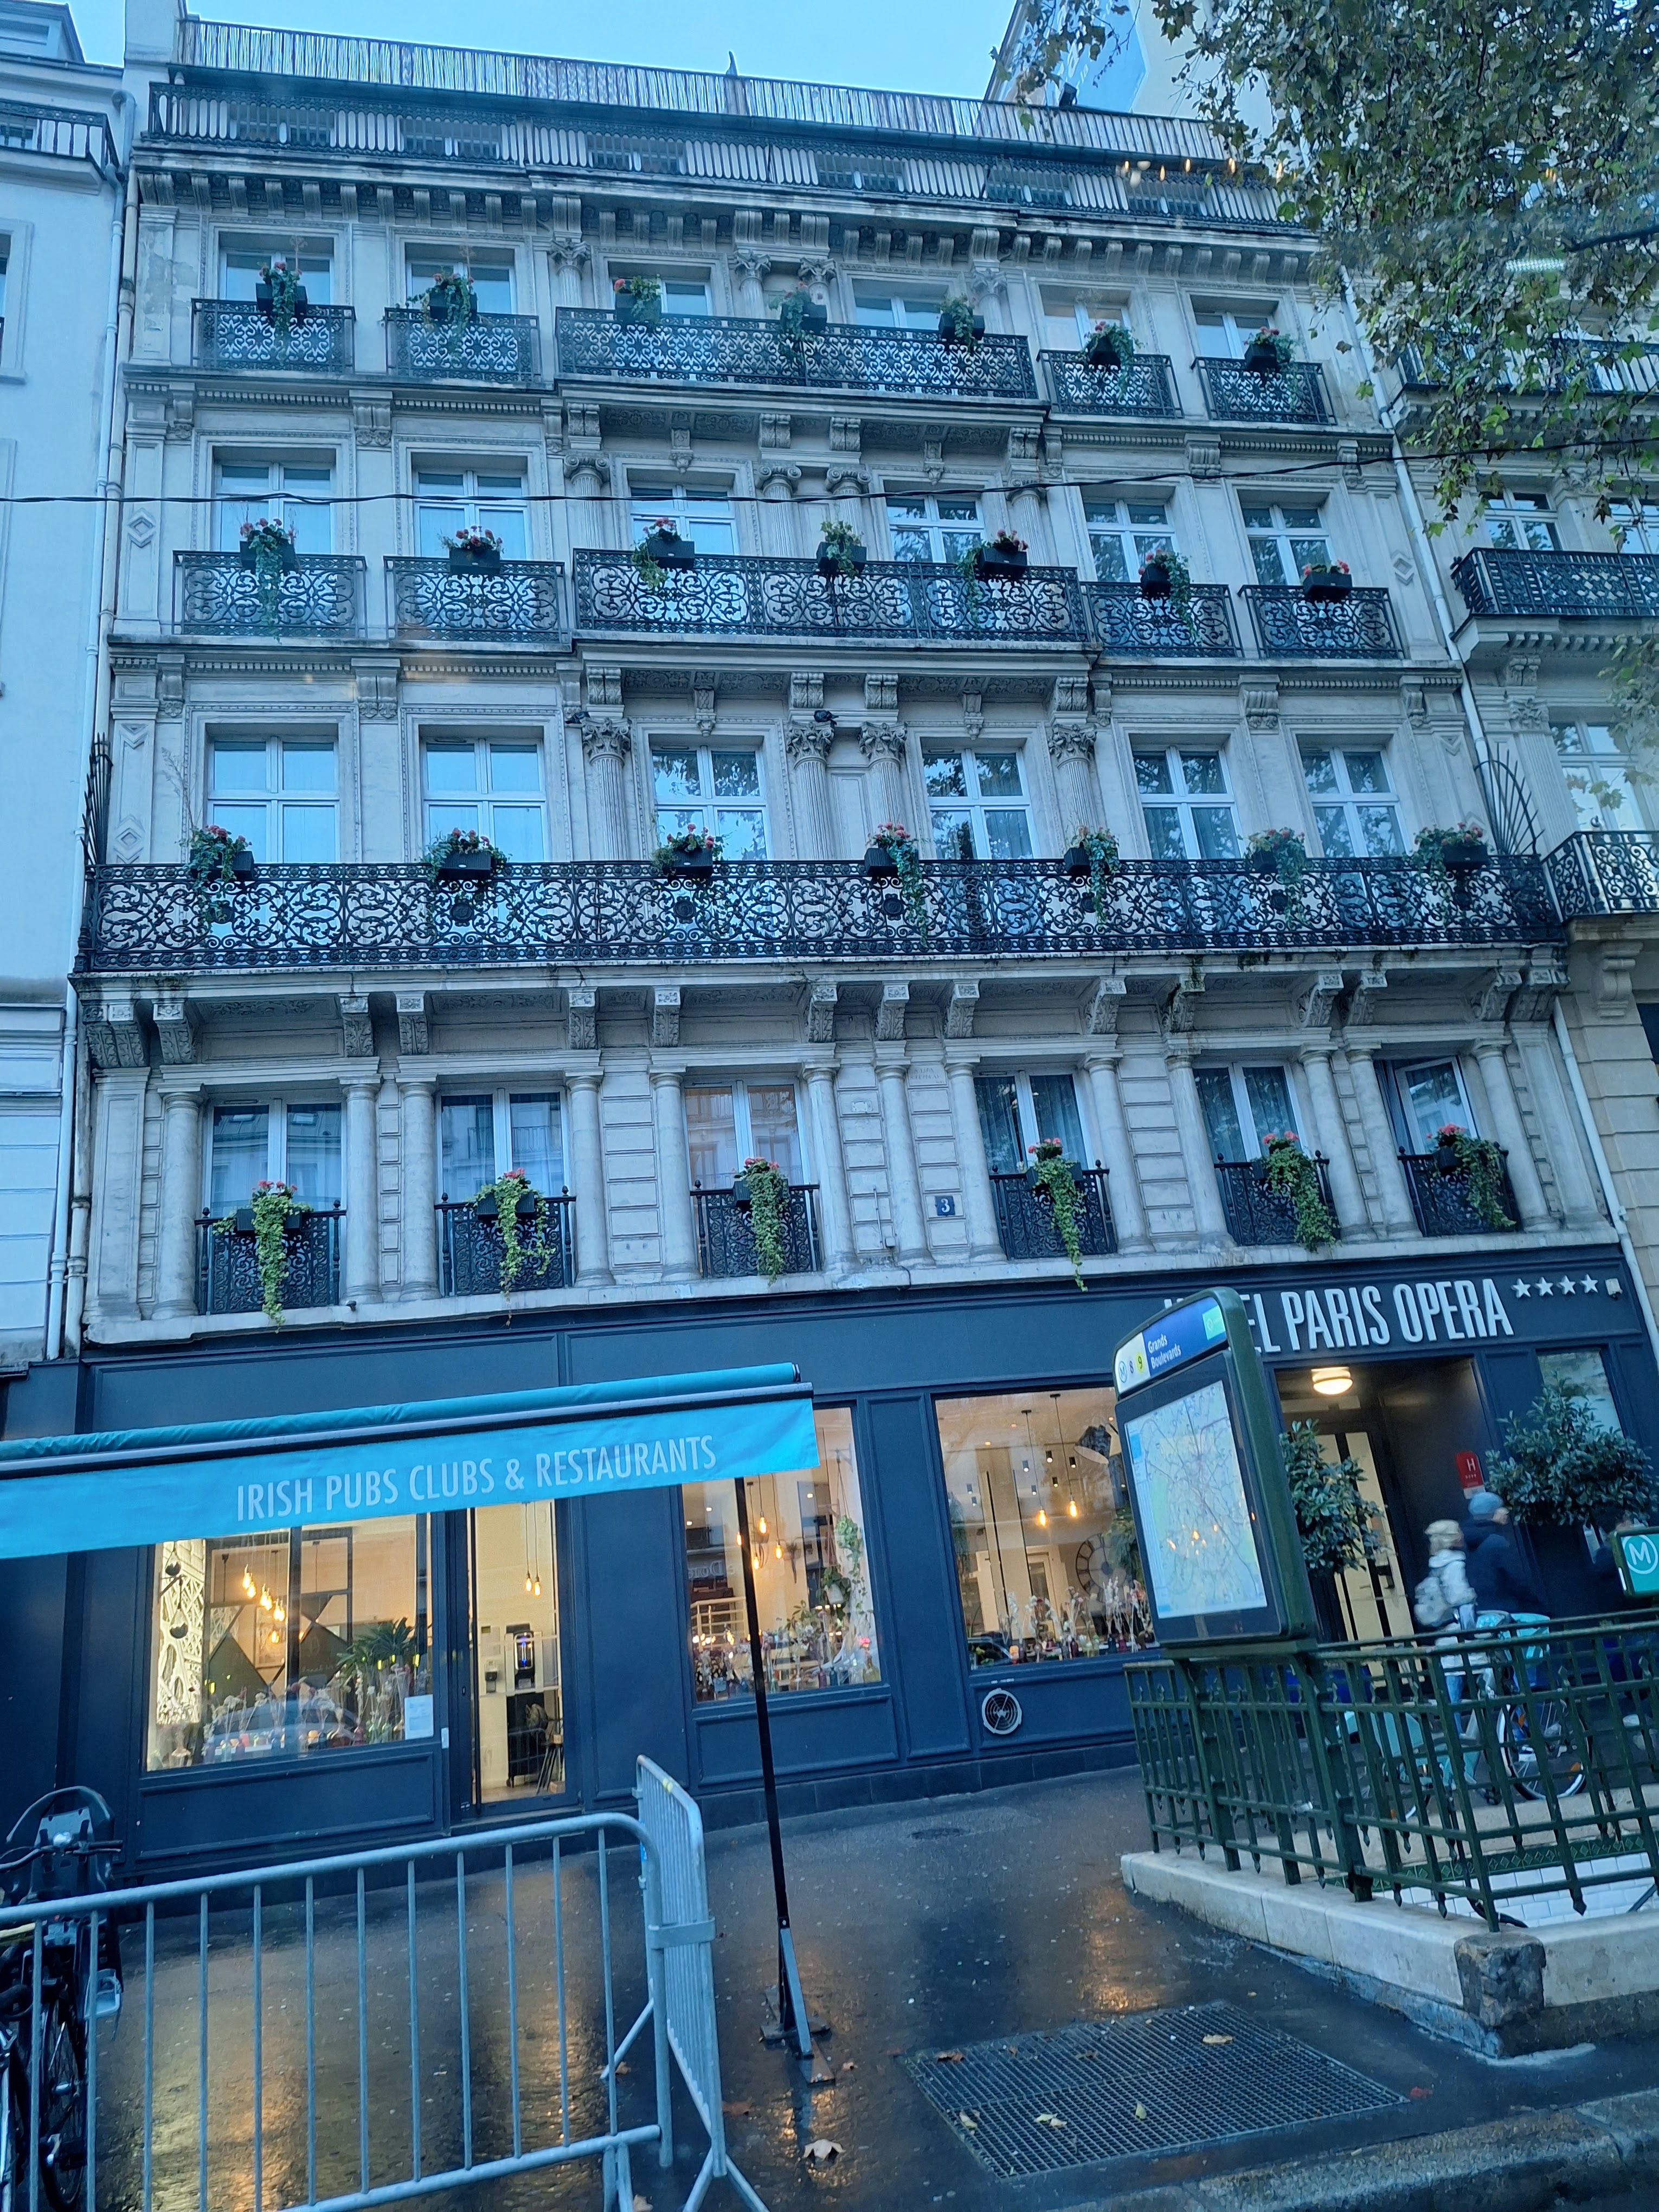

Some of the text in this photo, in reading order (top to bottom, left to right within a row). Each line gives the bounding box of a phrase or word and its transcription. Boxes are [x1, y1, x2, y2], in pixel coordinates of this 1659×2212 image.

[941, 1198, 950, 1213] 3
[1281, 1285, 1391, 1352] PARIS
[1393, 1278, 1515, 1342] OPERA
[1148, 1334, 1167, 1354] Grands
[1129, 1361, 1134, 1374] 8
[1137, 1355, 1143, 1369] 9
[1150, 1344, 1181, 1369] Boulevards
[1466, 1457, 1476, 1471] H
[237, 1434, 717, 1521] IRISH PUBS CLUBS & RESTAURANTS
[1628, 1541, 1651, 1566] M
